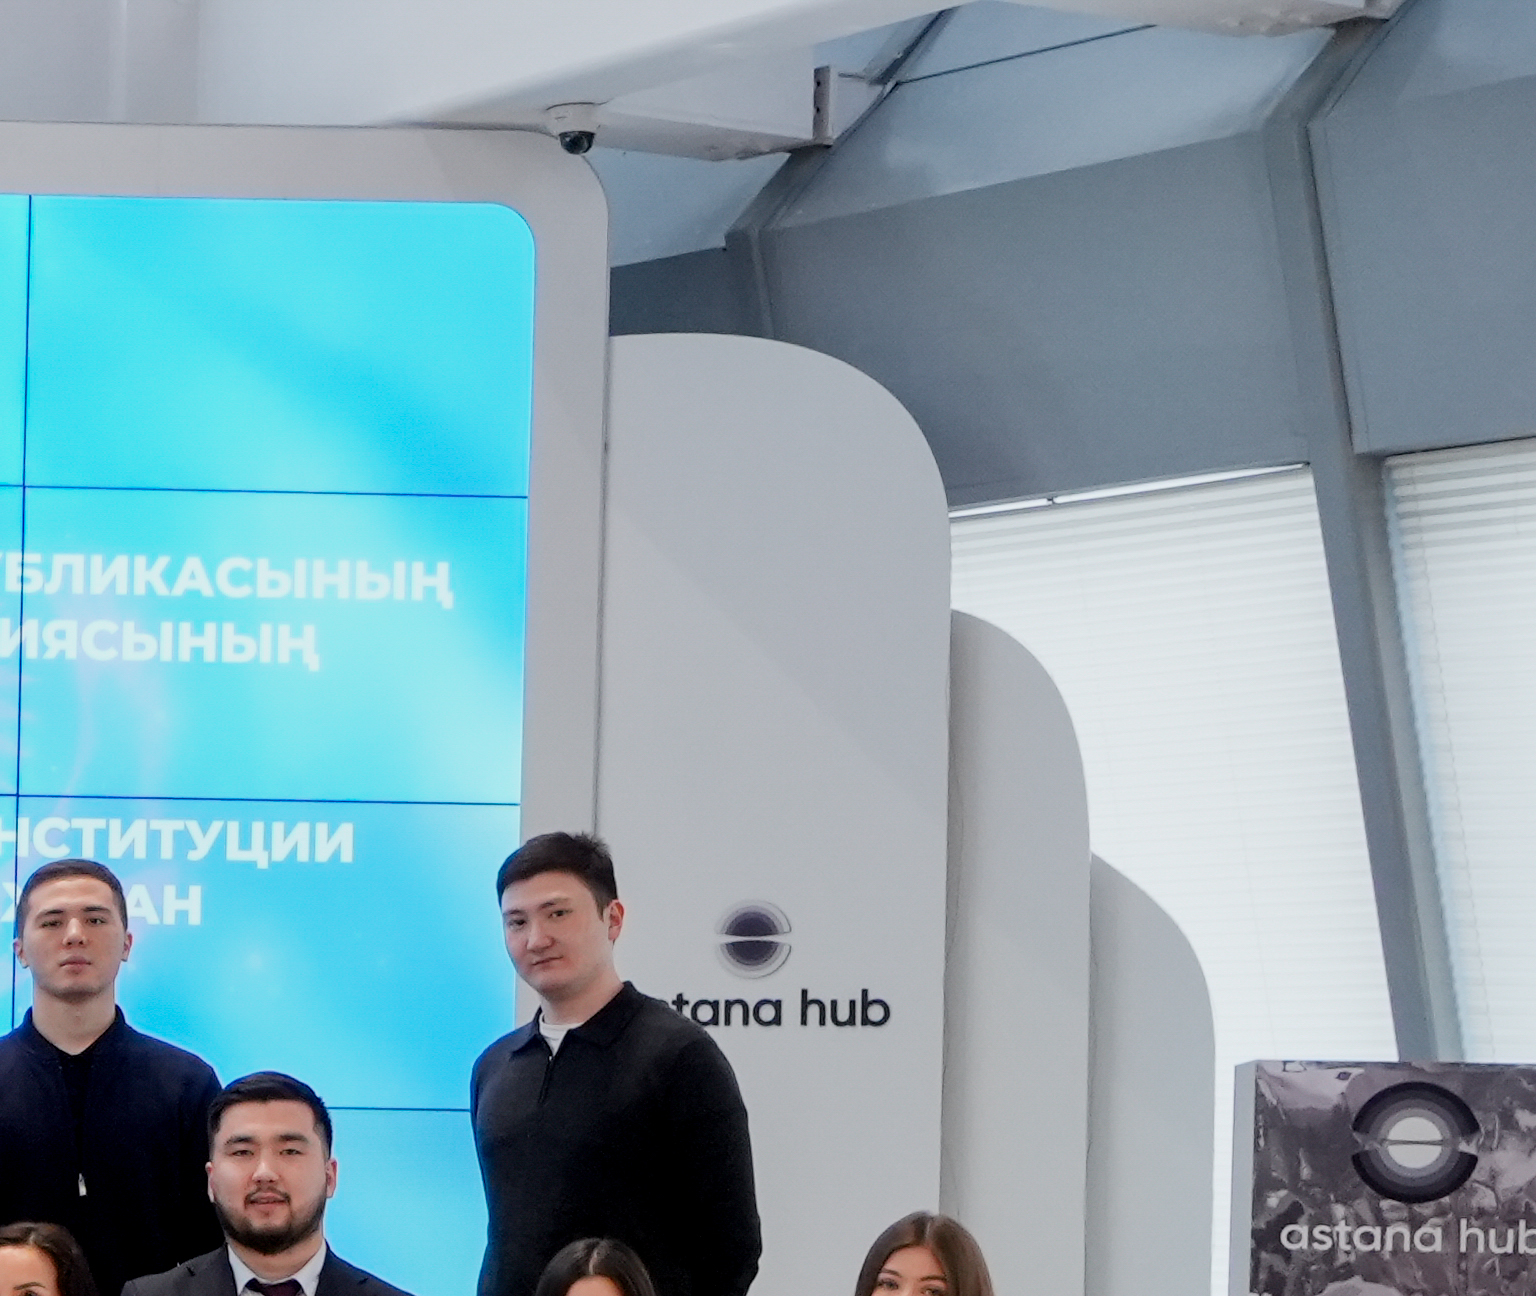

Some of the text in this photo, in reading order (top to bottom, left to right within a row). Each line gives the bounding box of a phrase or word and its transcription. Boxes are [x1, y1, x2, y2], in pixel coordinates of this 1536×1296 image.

[671, 988, 891, 1027] tana hub
[1280, 1217, 1536, 1255] astana hub
